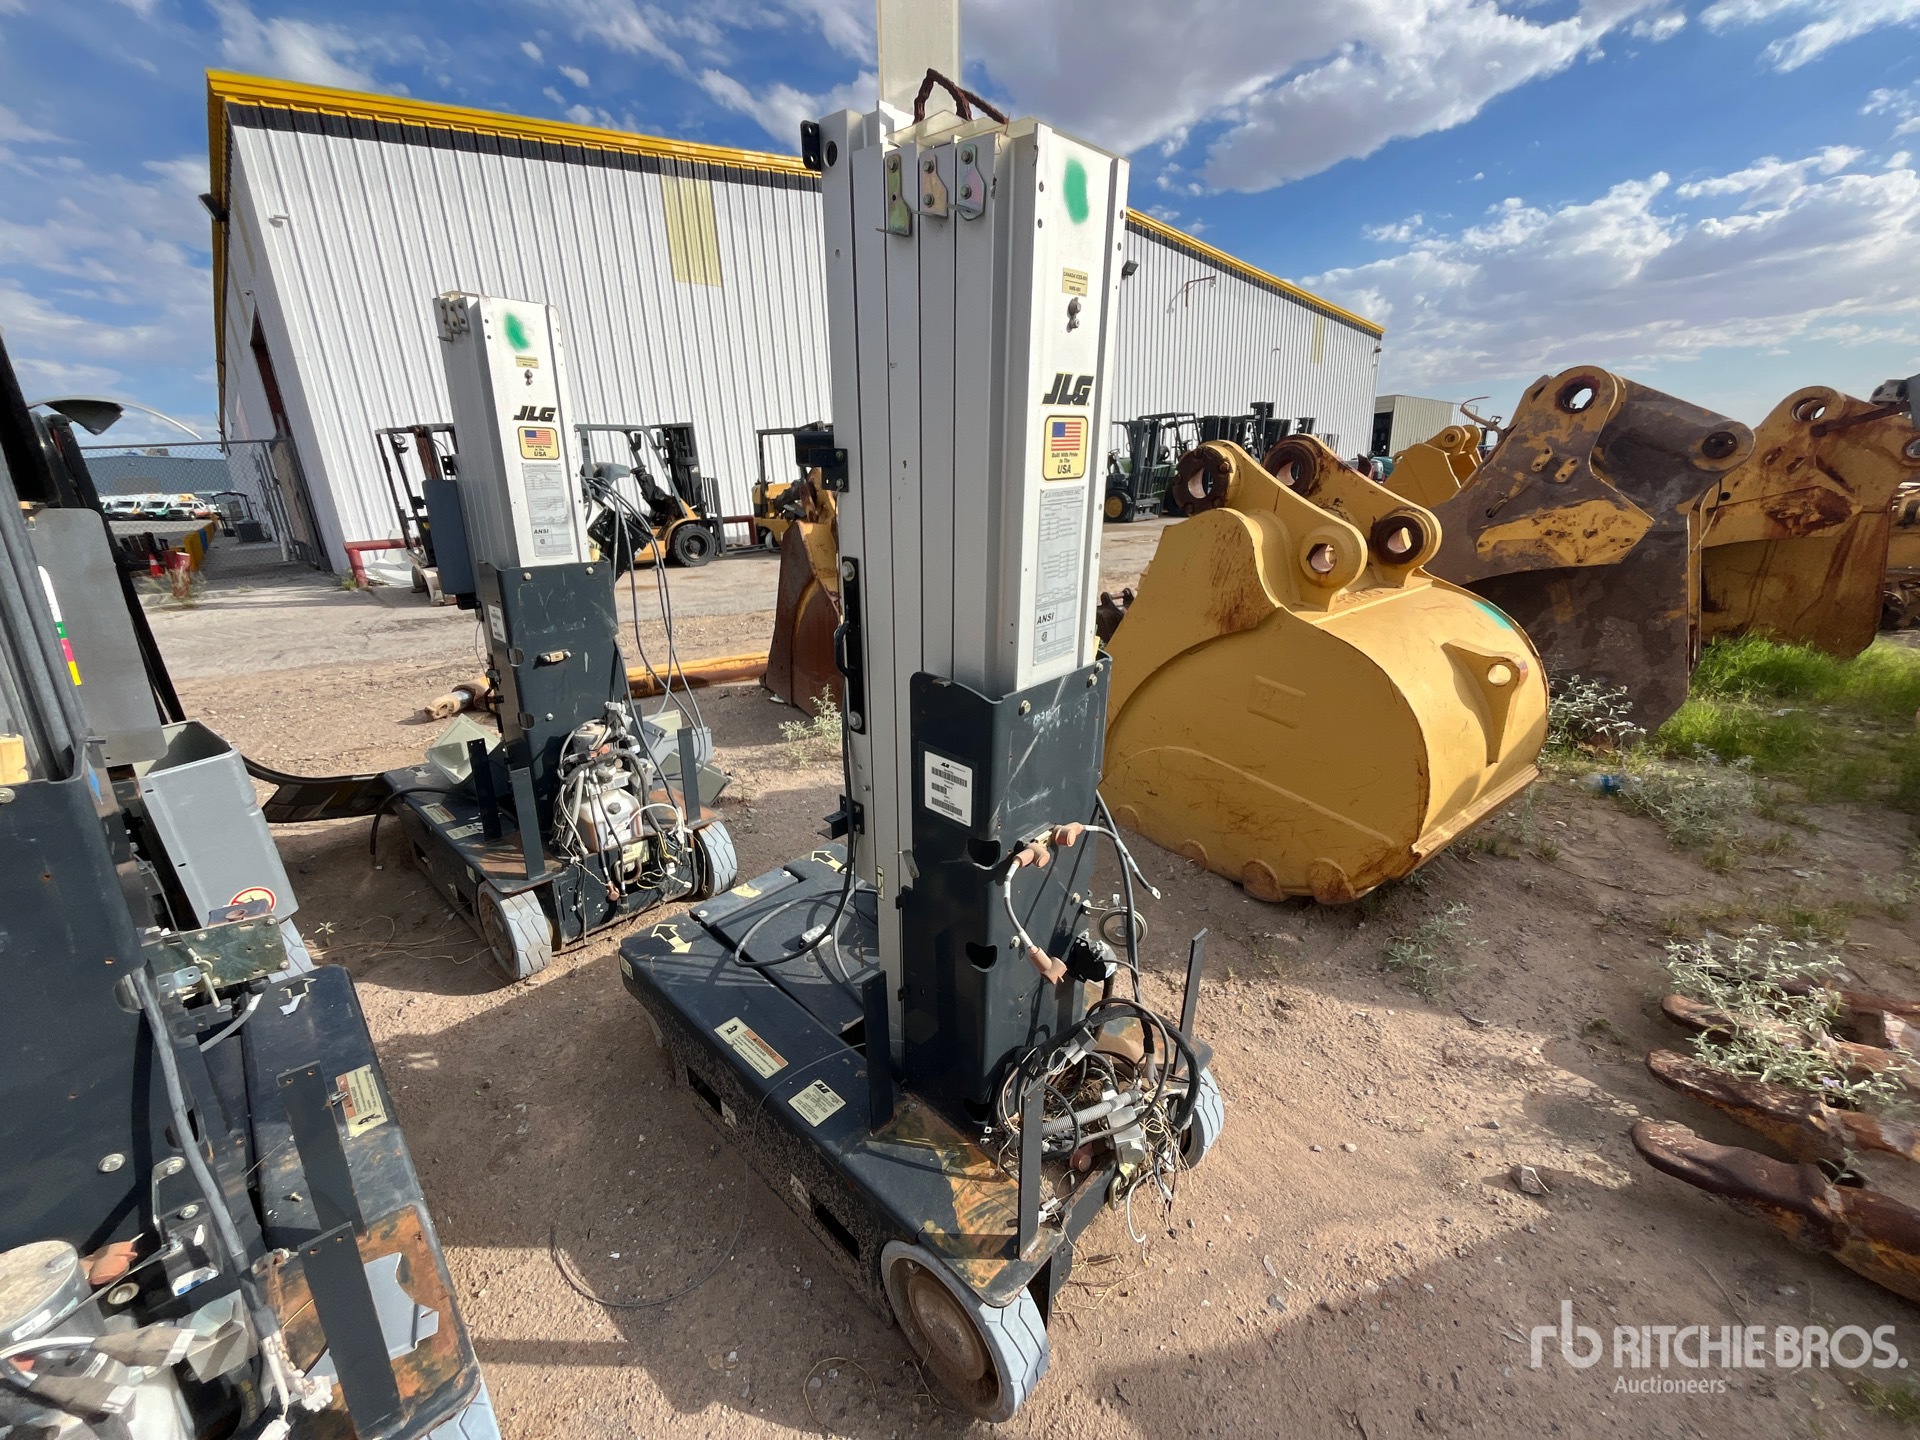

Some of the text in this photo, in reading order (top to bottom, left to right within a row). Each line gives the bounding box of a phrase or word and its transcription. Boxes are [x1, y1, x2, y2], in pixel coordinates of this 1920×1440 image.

[1042, 373, 1094, 405] JLG
[513, 405, 556, 422] JLG
[1057, 464, 1072, 474] USA
[1036, 612, 1054, 624] ANSI
[814, 1083, 831, 1094] JLG
